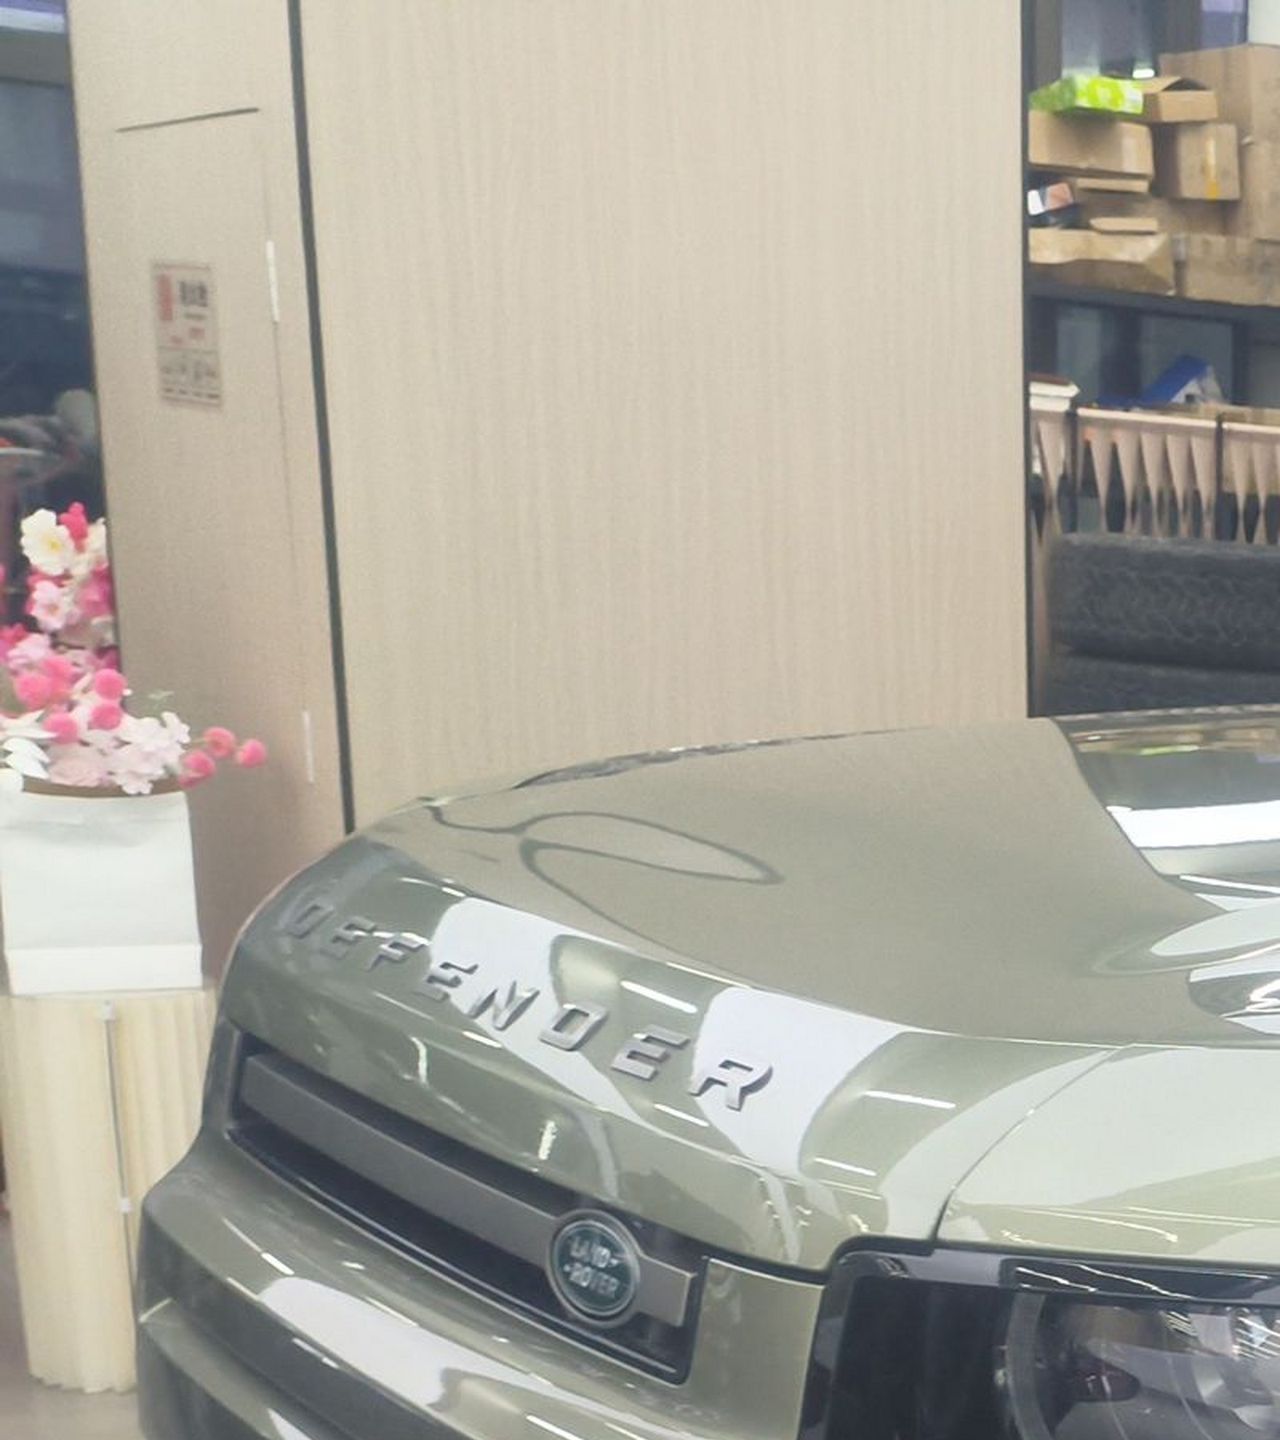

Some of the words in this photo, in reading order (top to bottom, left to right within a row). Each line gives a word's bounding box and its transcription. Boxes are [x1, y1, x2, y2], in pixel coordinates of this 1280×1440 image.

[280, 901, 775, 1112] DEFENDER
[570, 1234, 612, 1269] LAND
[569, 1262, 621, 1298] ROVER
